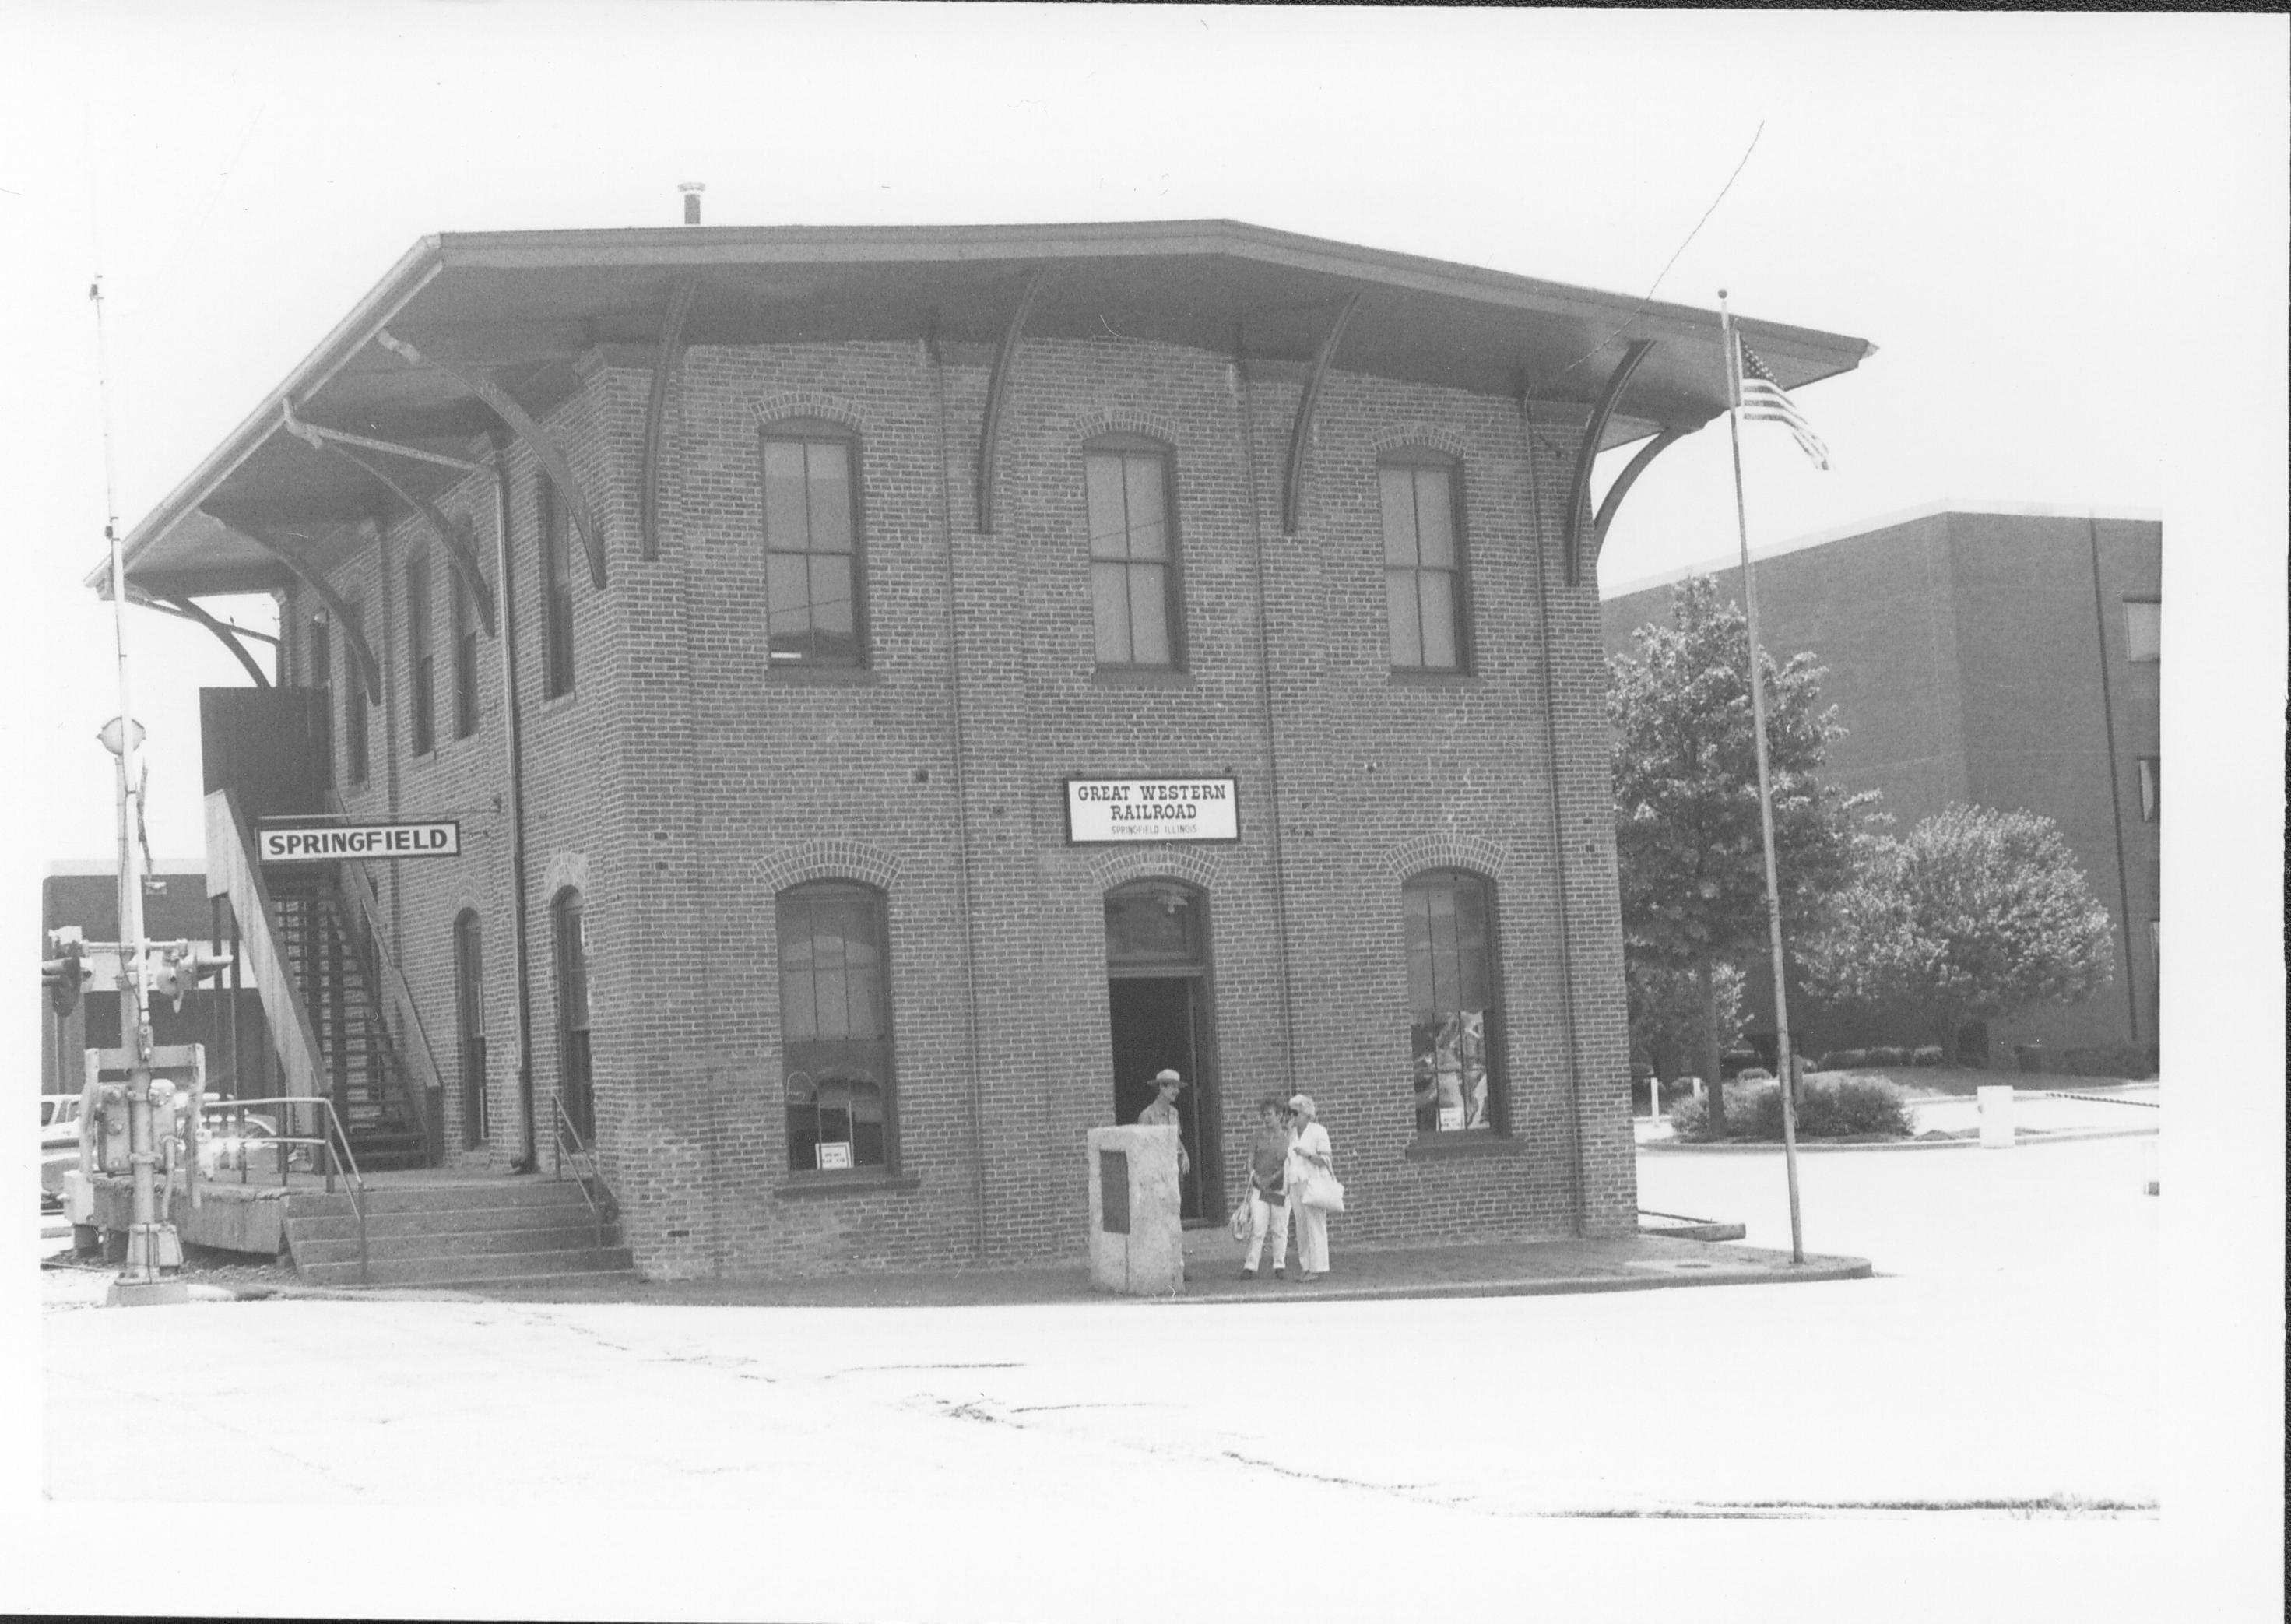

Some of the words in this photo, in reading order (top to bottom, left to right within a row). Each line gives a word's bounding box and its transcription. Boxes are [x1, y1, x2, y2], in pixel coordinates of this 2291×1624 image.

[1078, 786, 1130, 801] GREAT
[1140, 785, 1226, 800] WESTERN
[1110, 804, 1197, 821] RAILROAD
[1111, 825, 1159, 835] SPRINGFIELD
[1165, 824, 1197, 834] ILLINOIS
[269, 828, 448, 855] SPRINGFIELD
